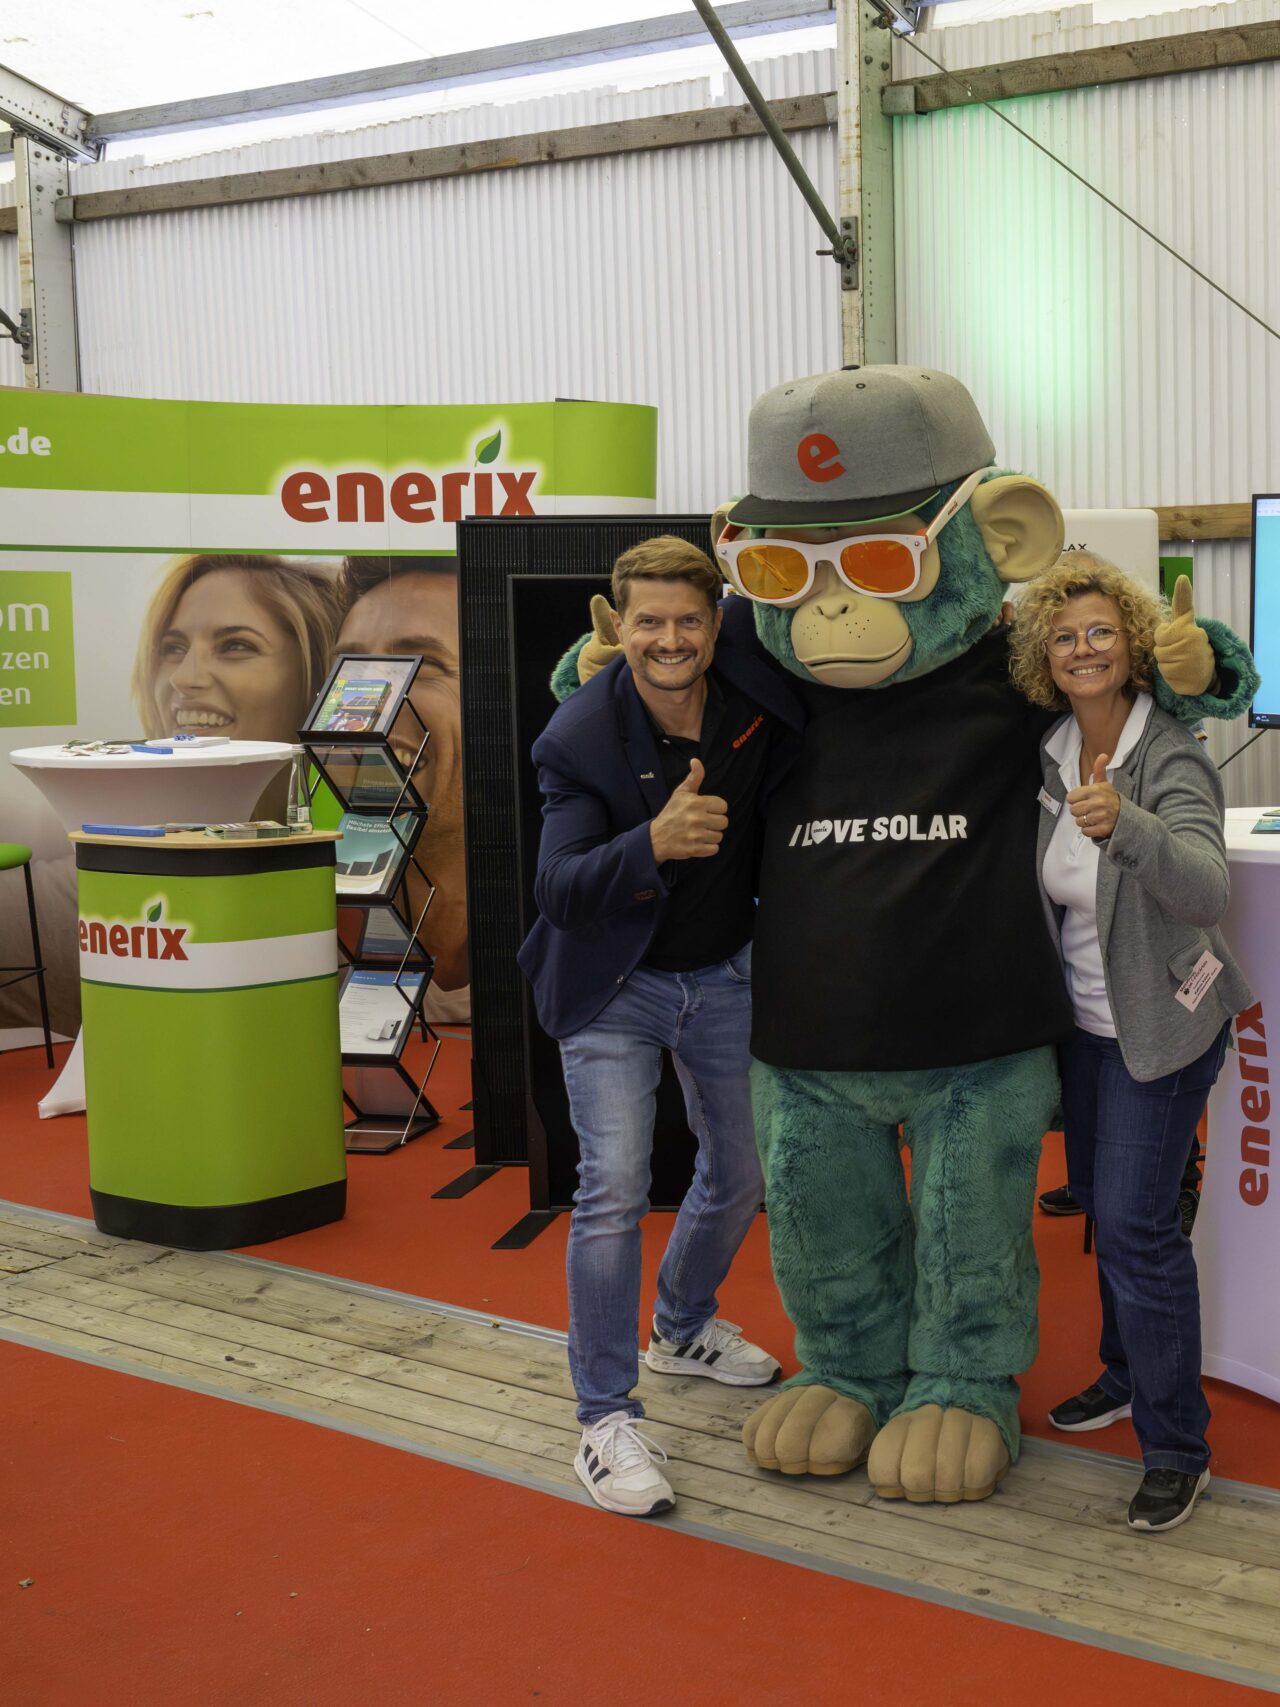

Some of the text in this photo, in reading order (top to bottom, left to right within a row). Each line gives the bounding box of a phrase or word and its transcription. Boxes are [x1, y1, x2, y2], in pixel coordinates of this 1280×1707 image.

[0, 426, 52, 456] .de
[797, 433, 847, 483] e
[281, 470, 538, 524] enerix
[0, 602, 49, 632] m
[871, 814, 968, 841] SOLAR
[78, 919, 190, 961] enerix
[1234, 1000, 1271, 1207] enerix
